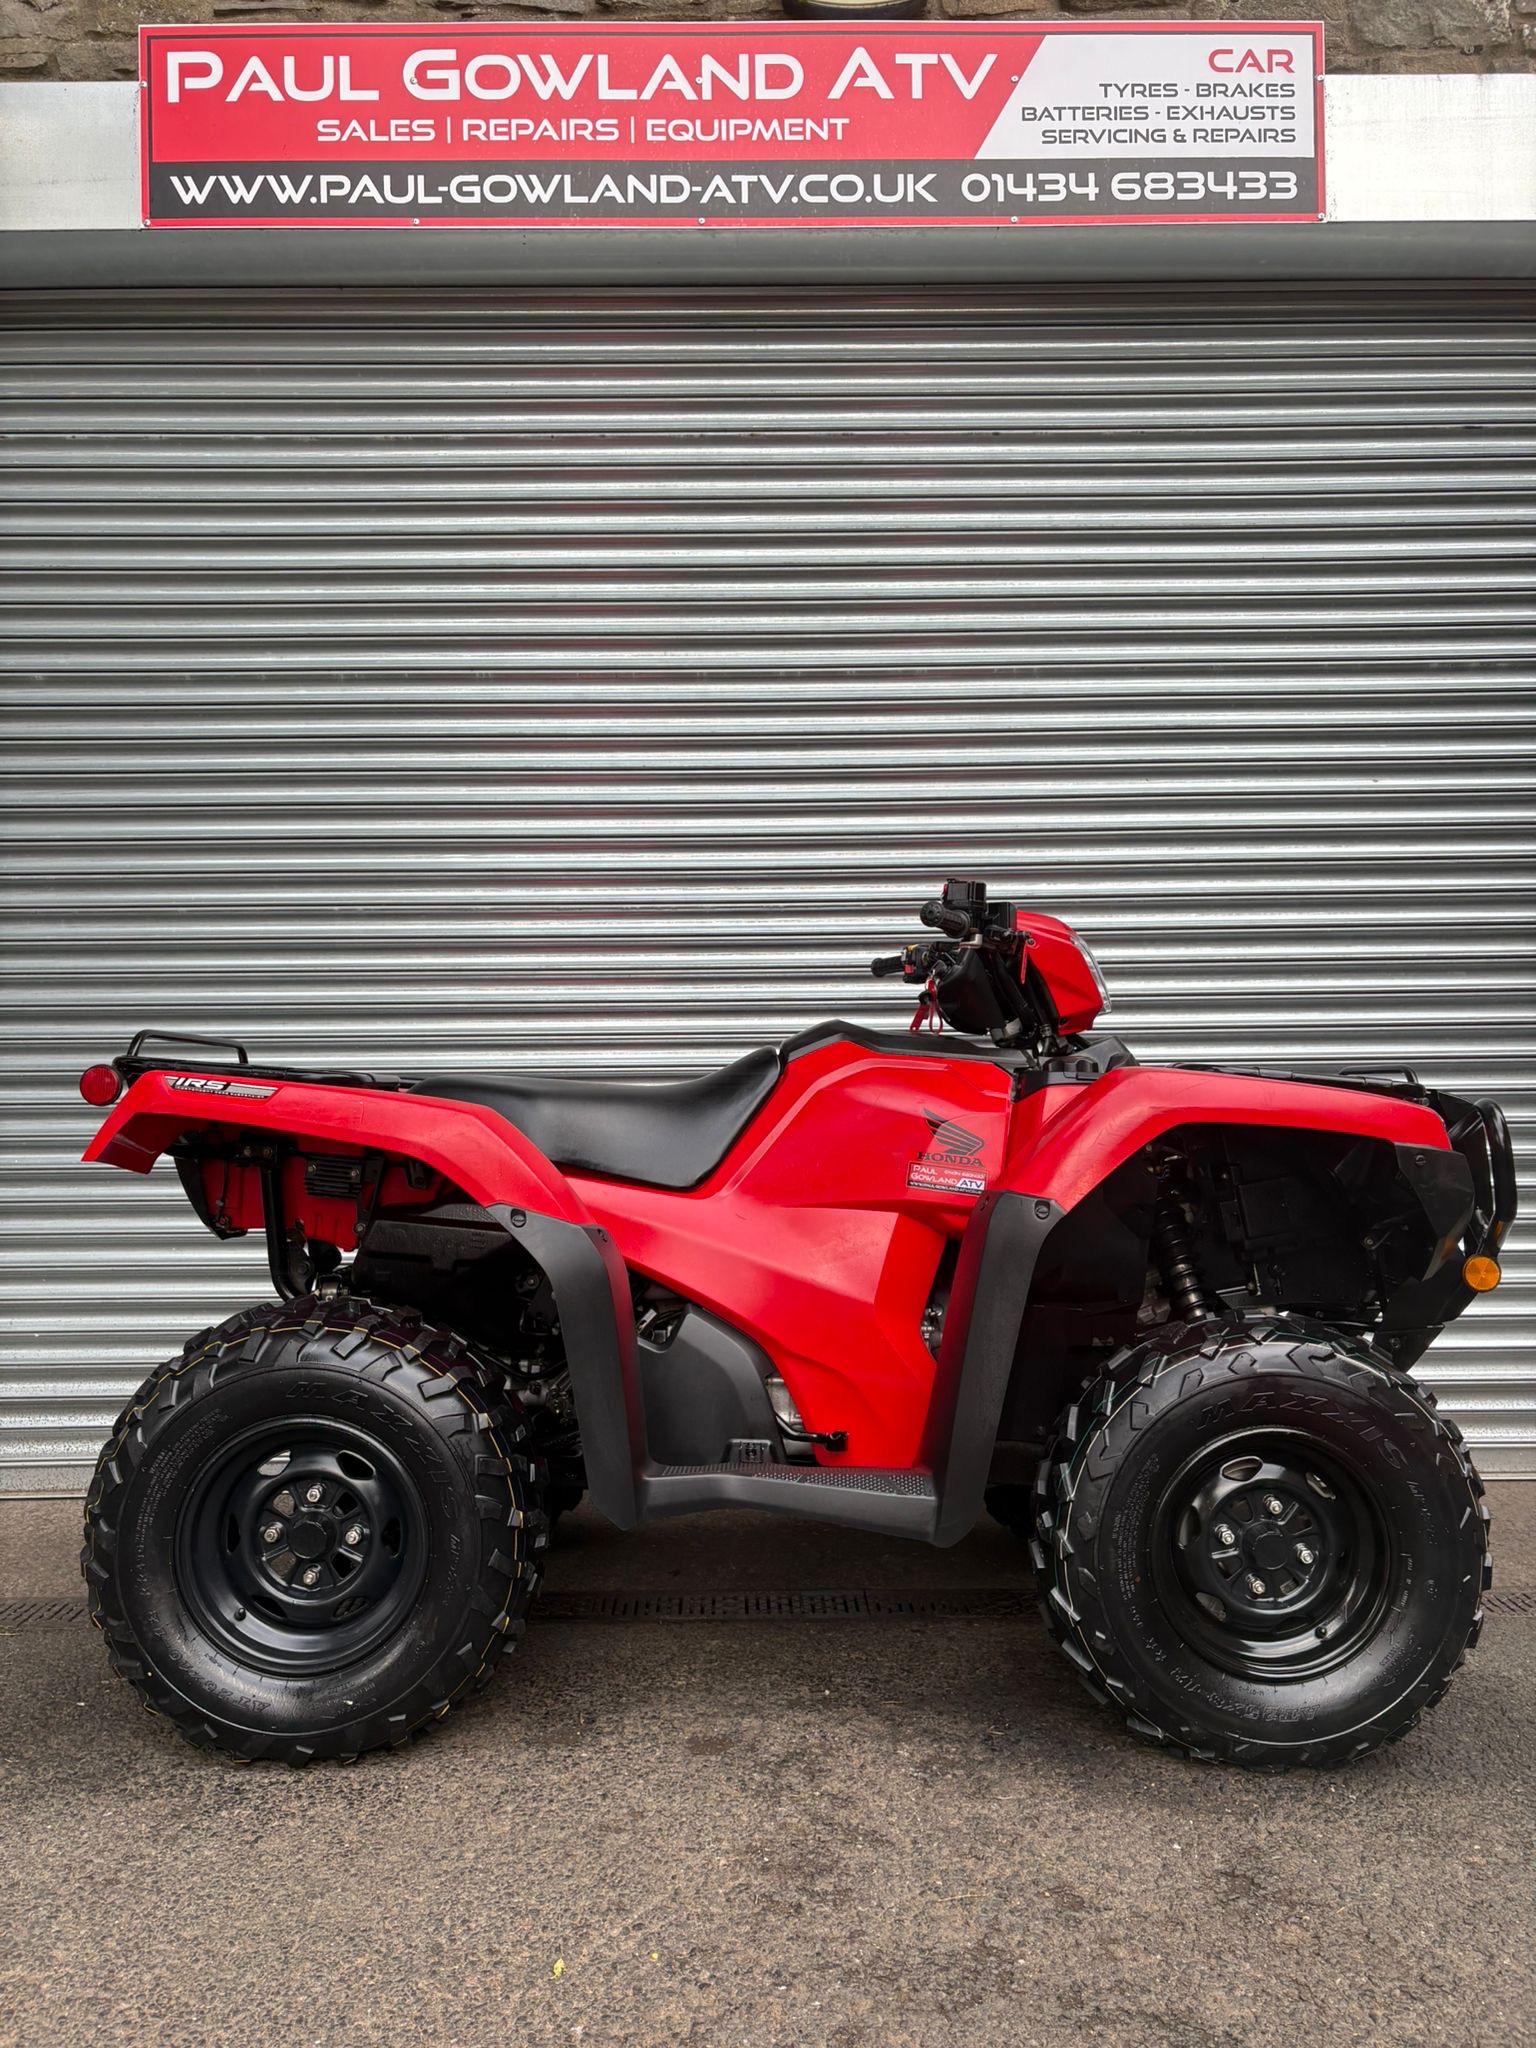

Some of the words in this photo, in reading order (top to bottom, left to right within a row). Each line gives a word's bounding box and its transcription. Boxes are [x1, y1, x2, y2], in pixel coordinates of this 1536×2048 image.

[1208, 49, 1295, 74] CAR
[166, 52, 380, 103] PAUL
[402, 48, 805, 101] GOWLAND
[827, 46, 998, 100] ATV
[1098, 83, 1179, 98] TYRES
[1196, 83, 1296, 98] BRAKES
[1021, 106, 1149, 122] BATTERIES
[1166, 105, 1296, 121] EXHAUSTS
[316, 119, 436, 142] SALES
[462, 118, 620, 142] REPAIRS
[646, 117, 850, 142] EQUIPMENT
[1041, 128, 1167, 144] SERVICING
[1173, 128, 1187, 143] &
[1193, 128, 1296, 144] REPAIRS
[169, 173, 939, 206] WWW.PAUL-GOWLAND-ATV.CO.UK
[960, 172, 1100, 203] 01434
[1110, 171, 1298, 201] 683433
[175, 1077, 227, 1090] IRS
[917, 1151, 984, 1168] HONDA
[913, 1165, 938, 1176] PAUL
[910, 1172, 958, 1185] GOWLAND
[960, 1179, 983, 1189] ATV
[1190, 1390, 1408, 1470] MAXXIS
[286, 1381, 457, 1518] MAXXIS
